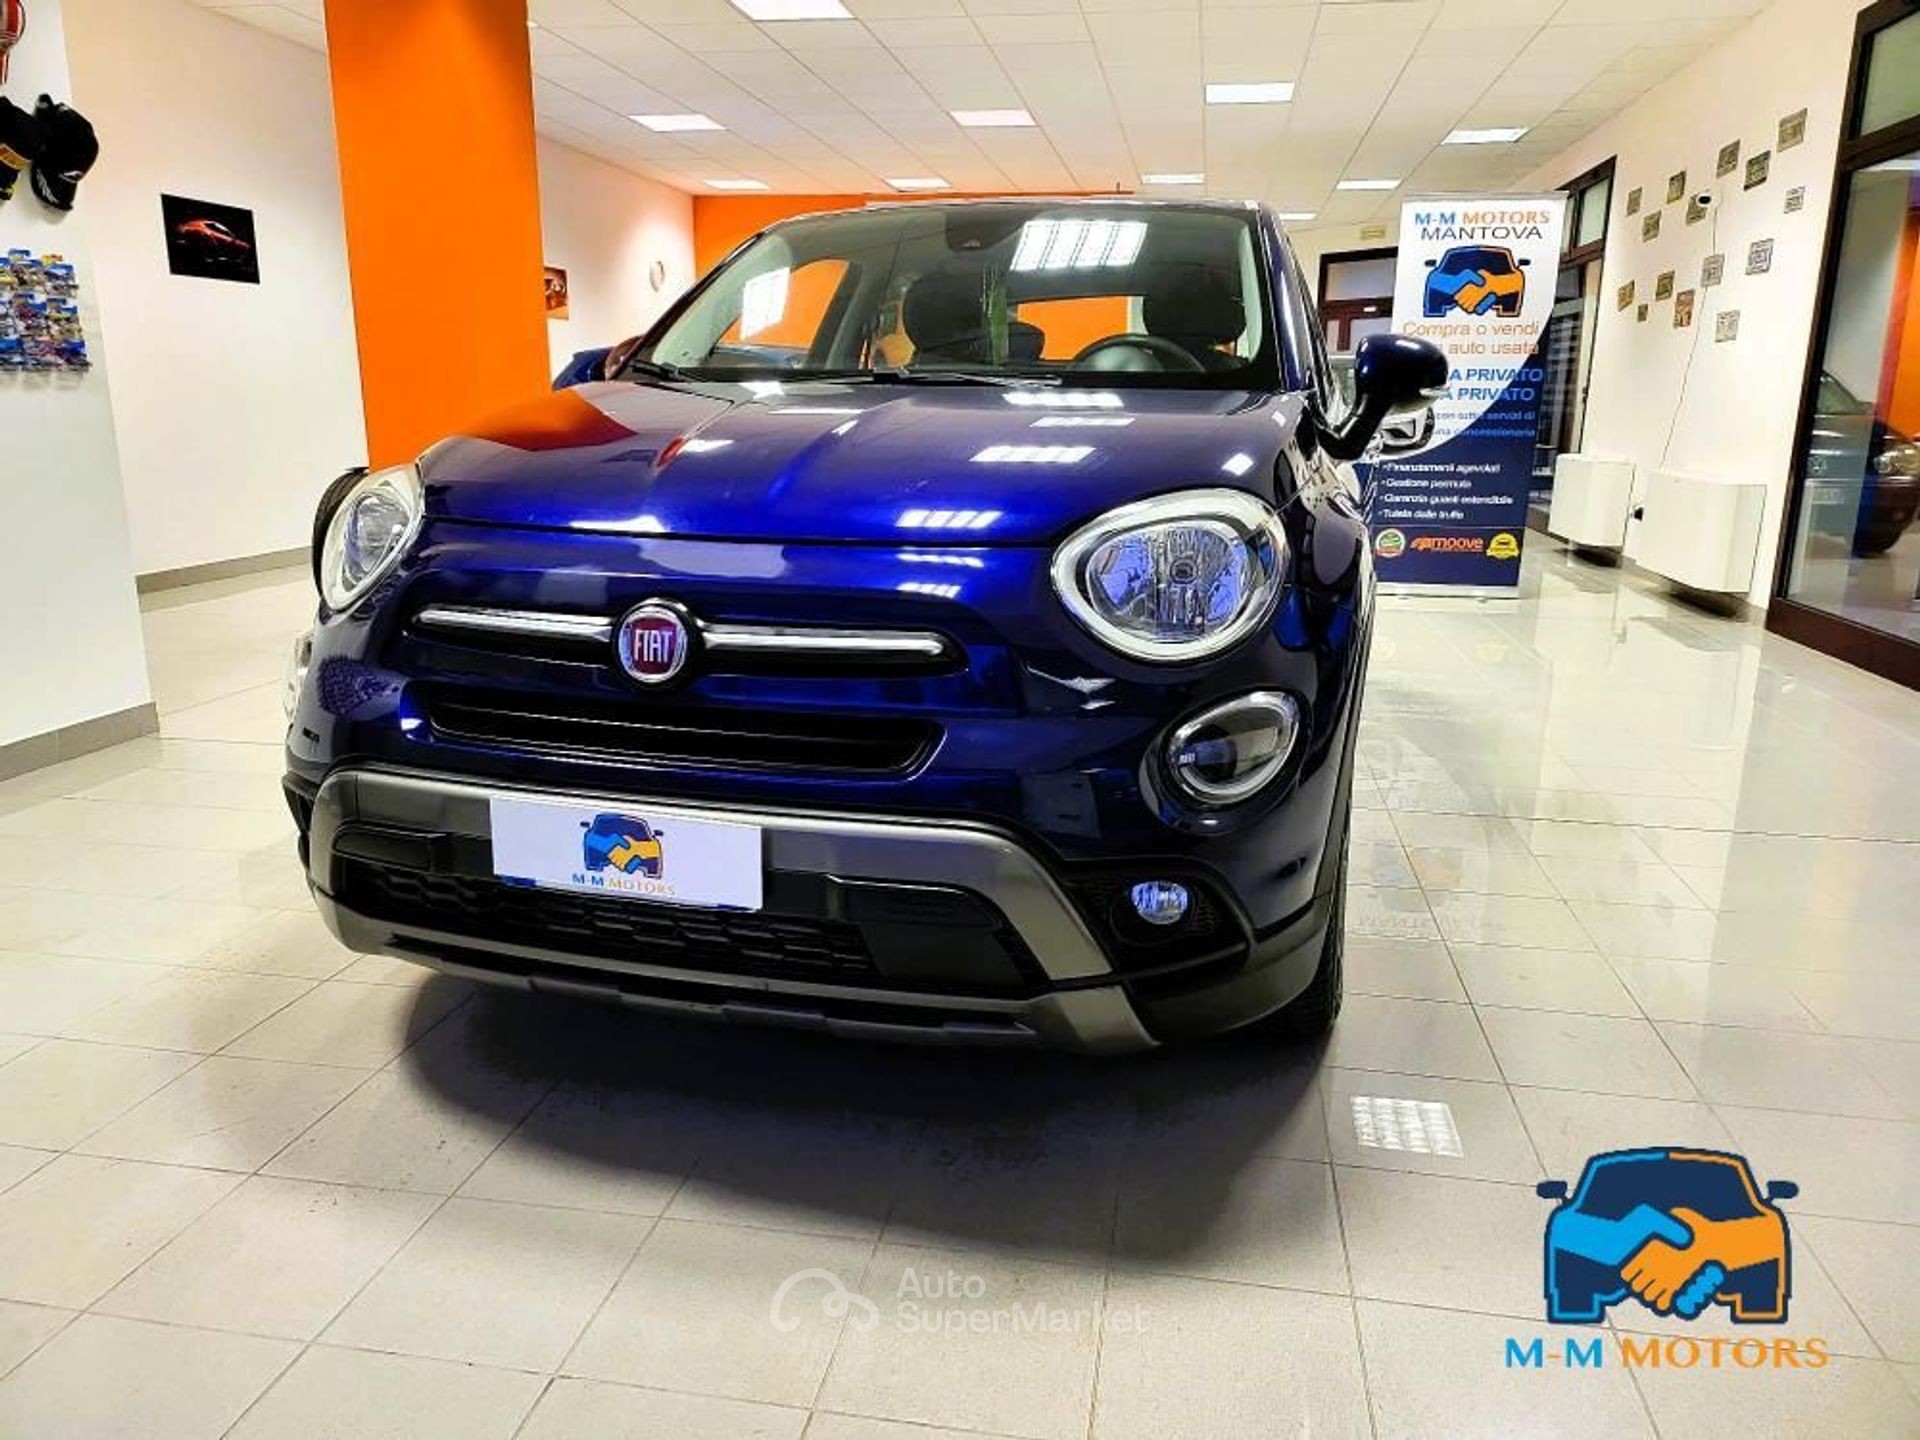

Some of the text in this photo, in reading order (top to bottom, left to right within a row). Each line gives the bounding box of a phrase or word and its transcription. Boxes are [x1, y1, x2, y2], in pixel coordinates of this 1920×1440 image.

[1414, 211, 1550, 225] M-M MOTORS
[1420, 226, 1543, 240] MANTOVA
[1403, 321, 1540, 337] Compra o vendi
[1448, 340, 1485, 354] auto
[1491, 340, 1539, 354] usata
[1466, 369, 1543, 381] PRIVATO
[1458, 388, 1535, 400] PRIVATO
[633, 628, 673, 663] FIAT
[572, 872, 676, 895] M-M MOTORS
